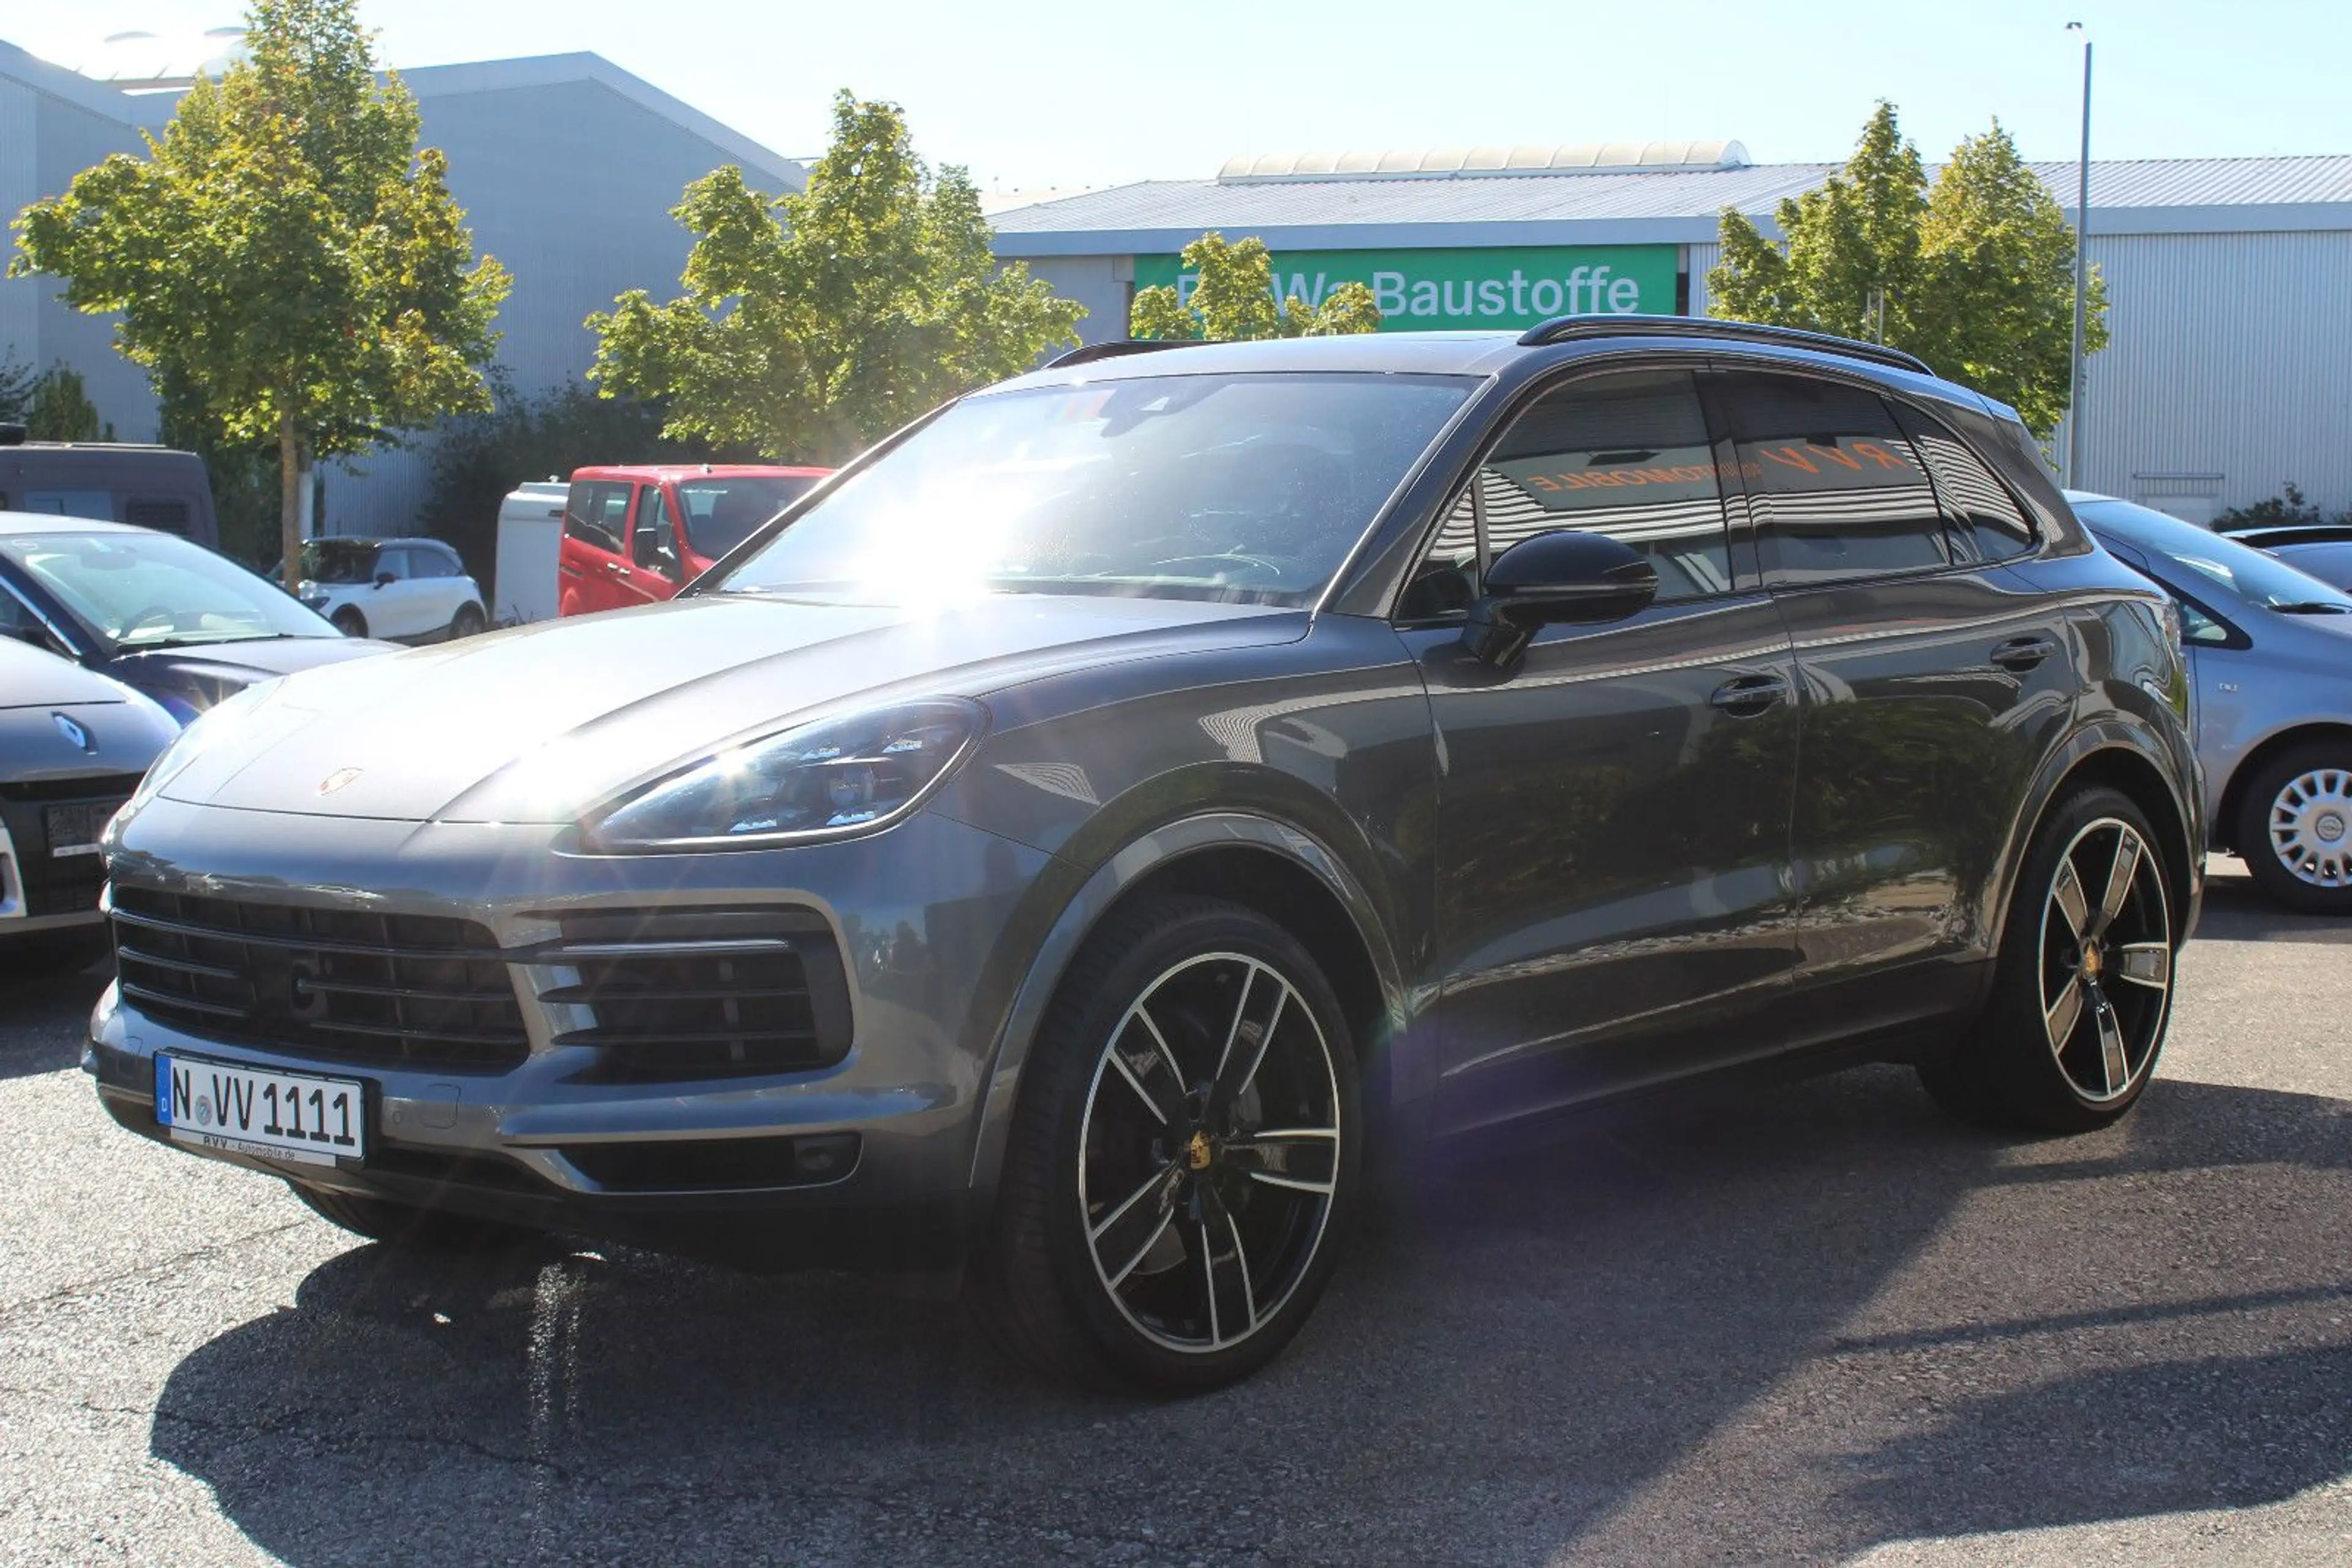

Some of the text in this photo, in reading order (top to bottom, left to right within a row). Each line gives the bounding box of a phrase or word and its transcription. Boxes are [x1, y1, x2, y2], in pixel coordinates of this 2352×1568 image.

[1373, 266, 1639, 316] Baustoffe
[173, 1066, 190, 1120] N
[203, 1136, 227, 1148] RVV
